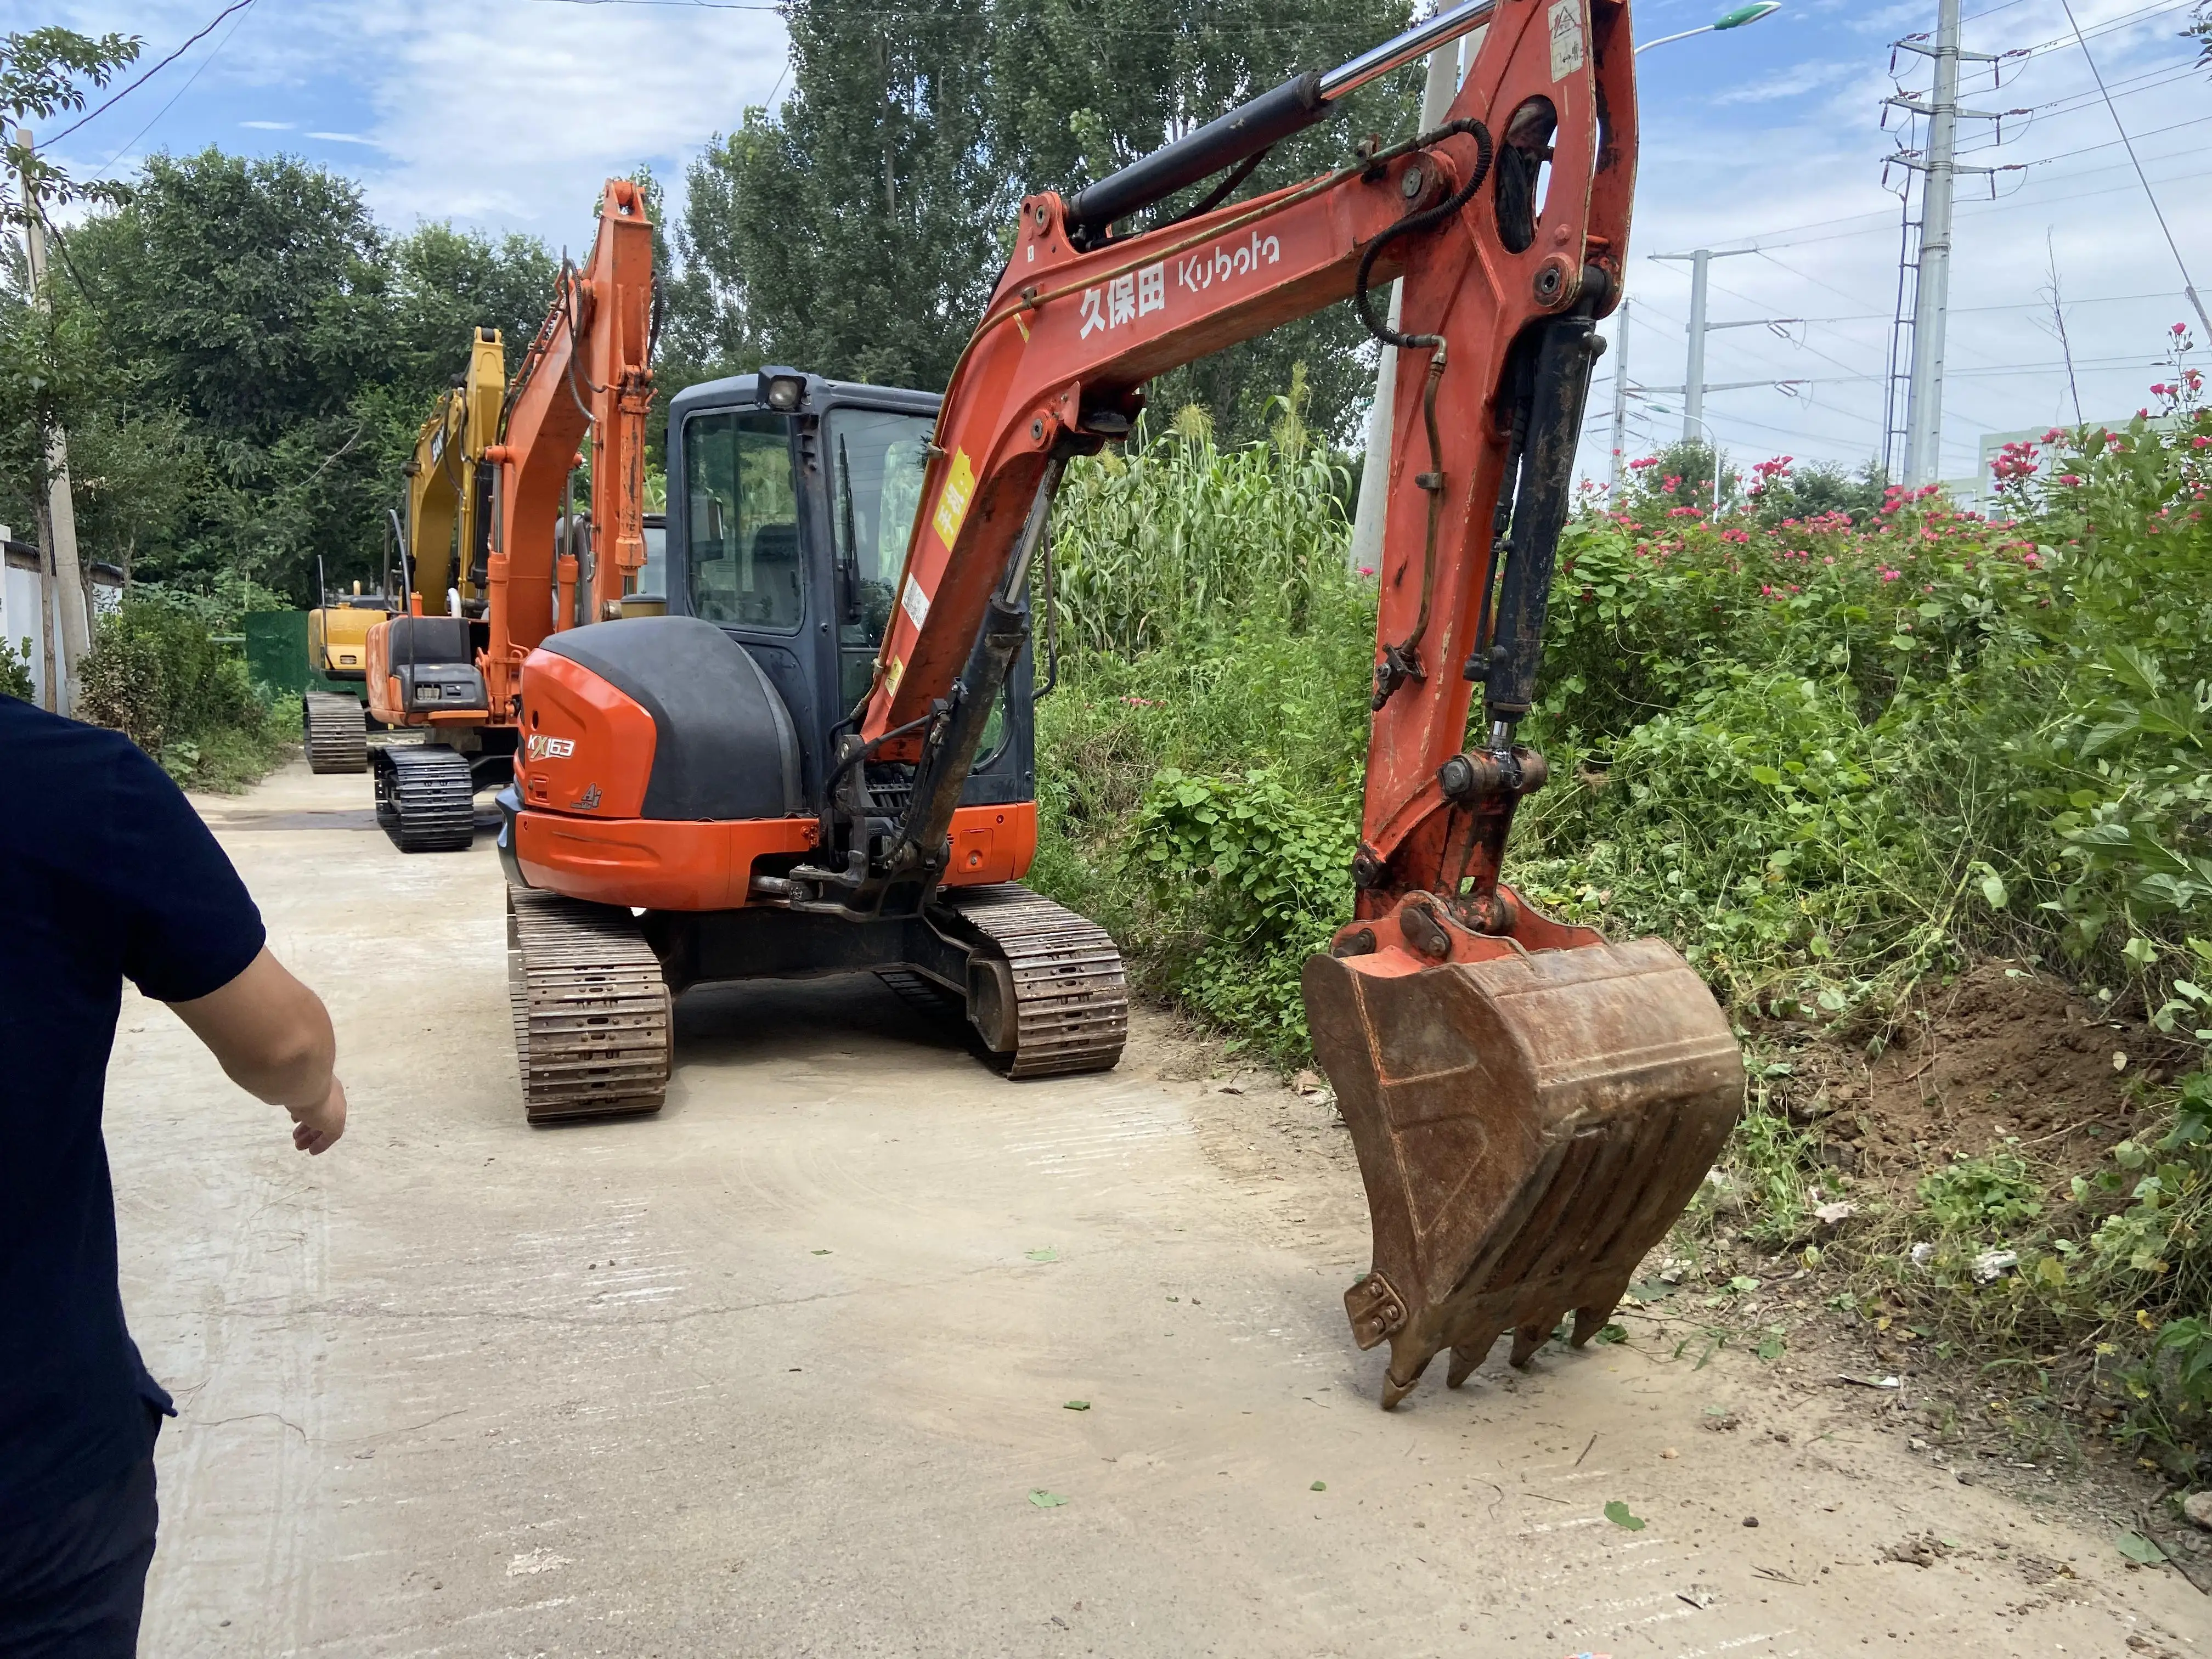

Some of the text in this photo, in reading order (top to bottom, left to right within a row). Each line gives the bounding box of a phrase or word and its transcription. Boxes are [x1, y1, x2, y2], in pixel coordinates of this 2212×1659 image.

[1079, 230, 1280, 340] 久保田 Kubota
[527, 734, 575, 759] KX163
